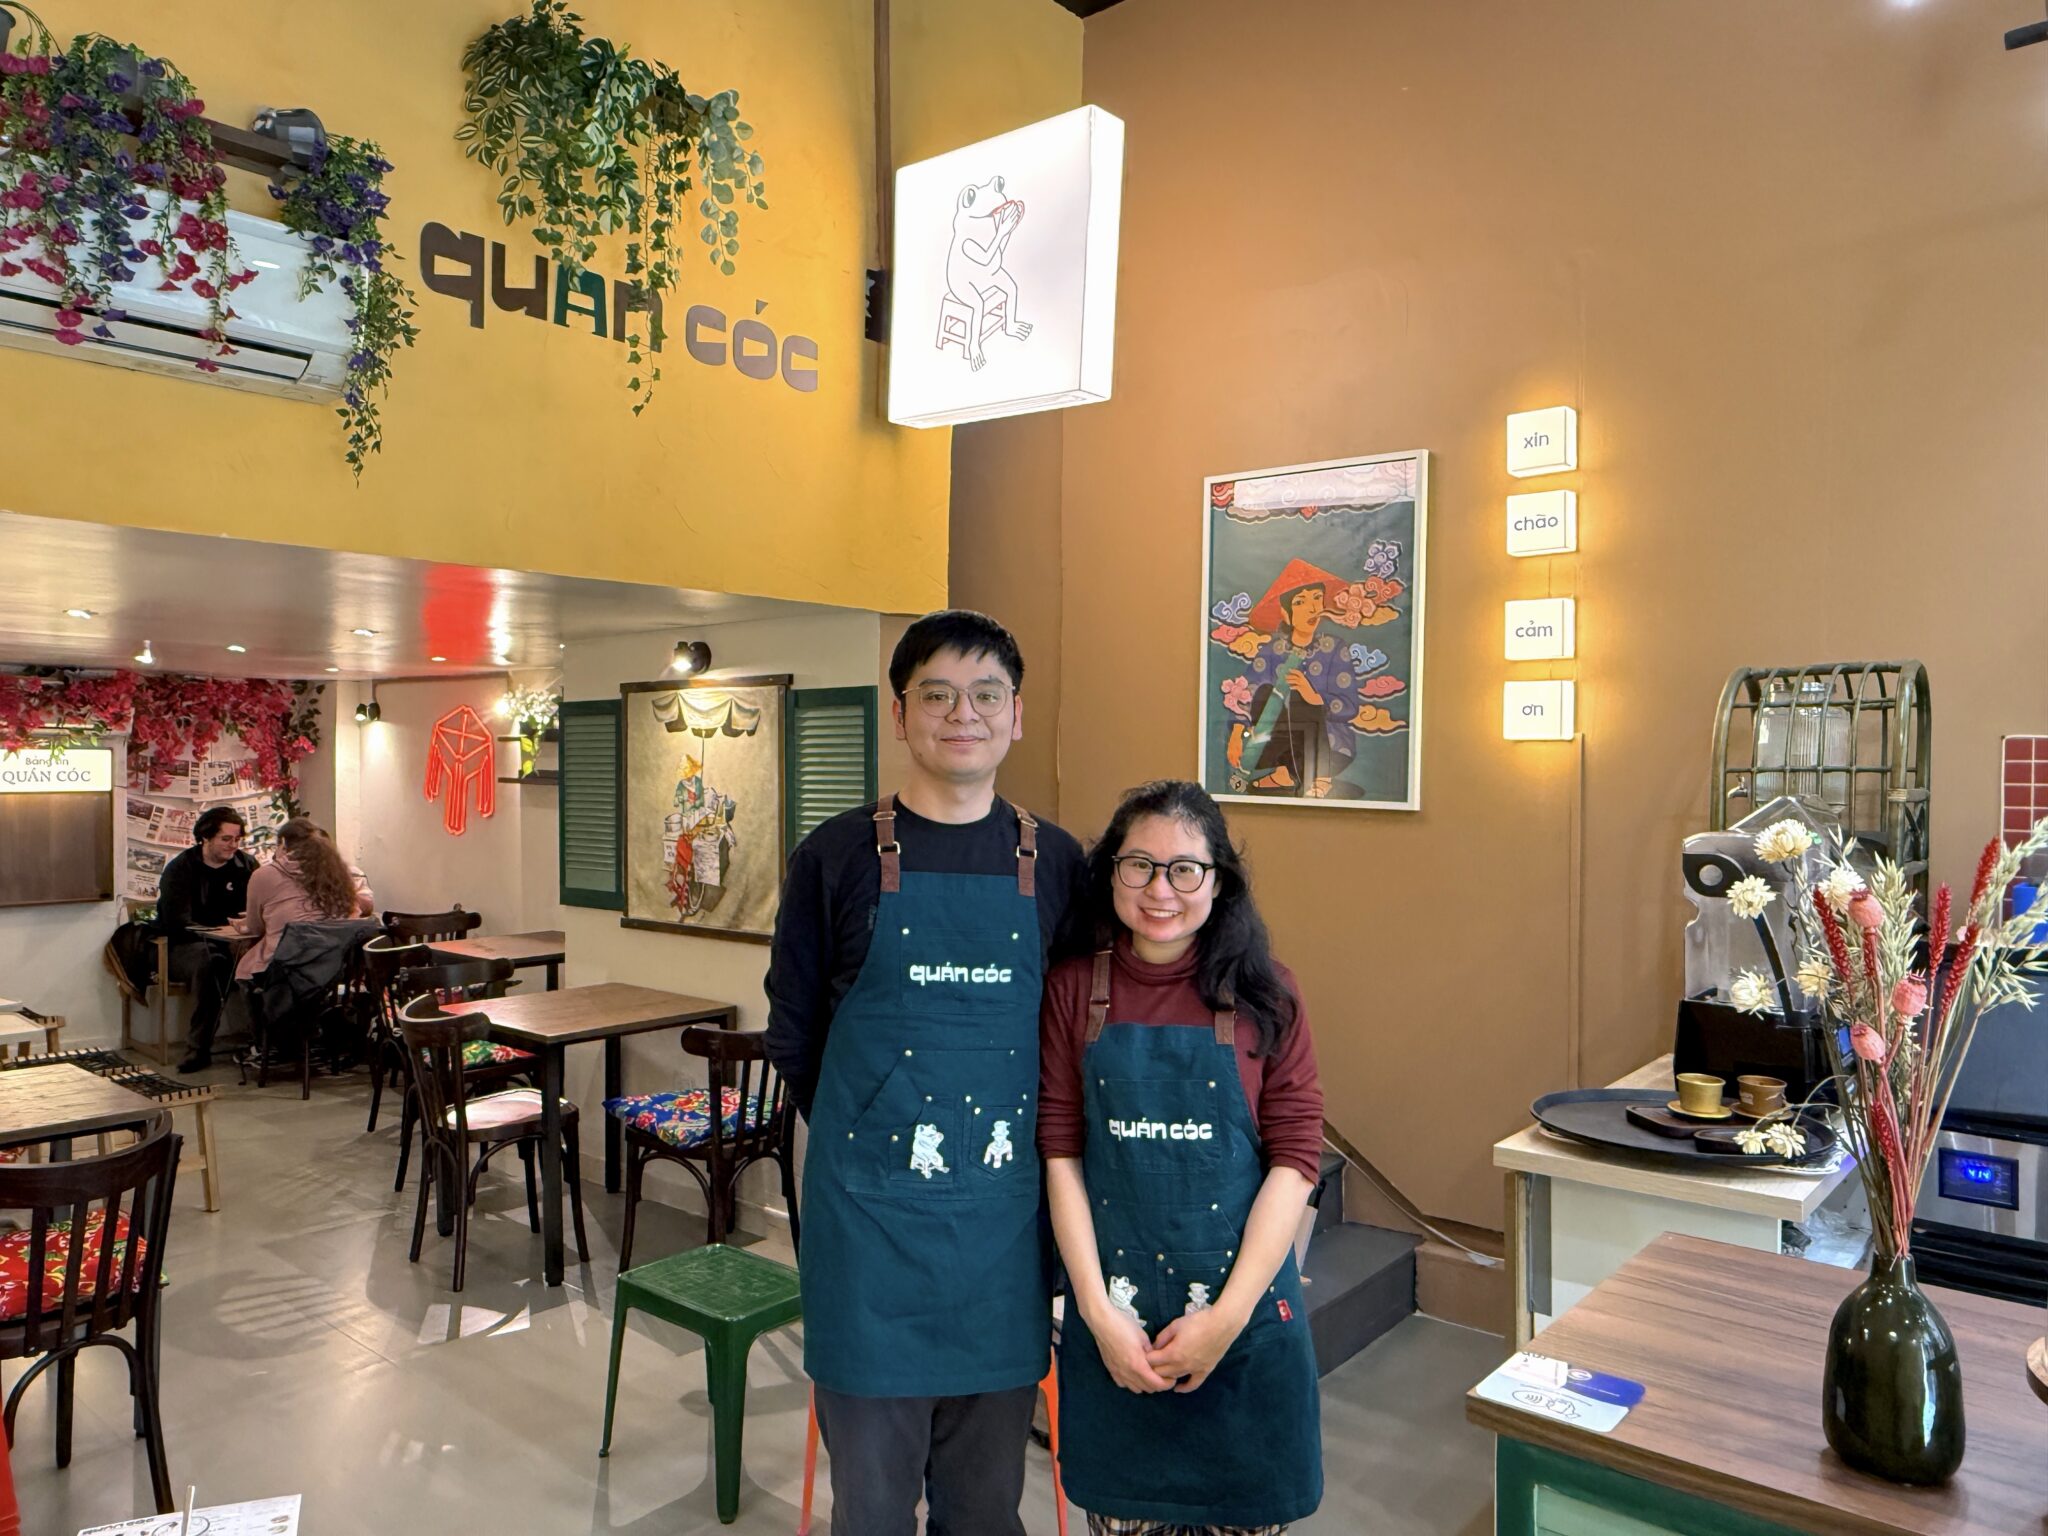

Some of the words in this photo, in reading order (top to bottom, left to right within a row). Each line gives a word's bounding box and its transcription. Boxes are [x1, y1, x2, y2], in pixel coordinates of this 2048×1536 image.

[685, 299, 818, 392] cóc
[1523, 432, 1550, 449] xin
[2, 767, 51, 785] QUÁN
[56, 767, 91, 783] CÓC
[909, 961, 969, 986] quán
[971, 963, 1012, 983] cóc
[1108, 1117, 1167, 1141] quán
[1170, 1118, 1213, 1140] cóc
